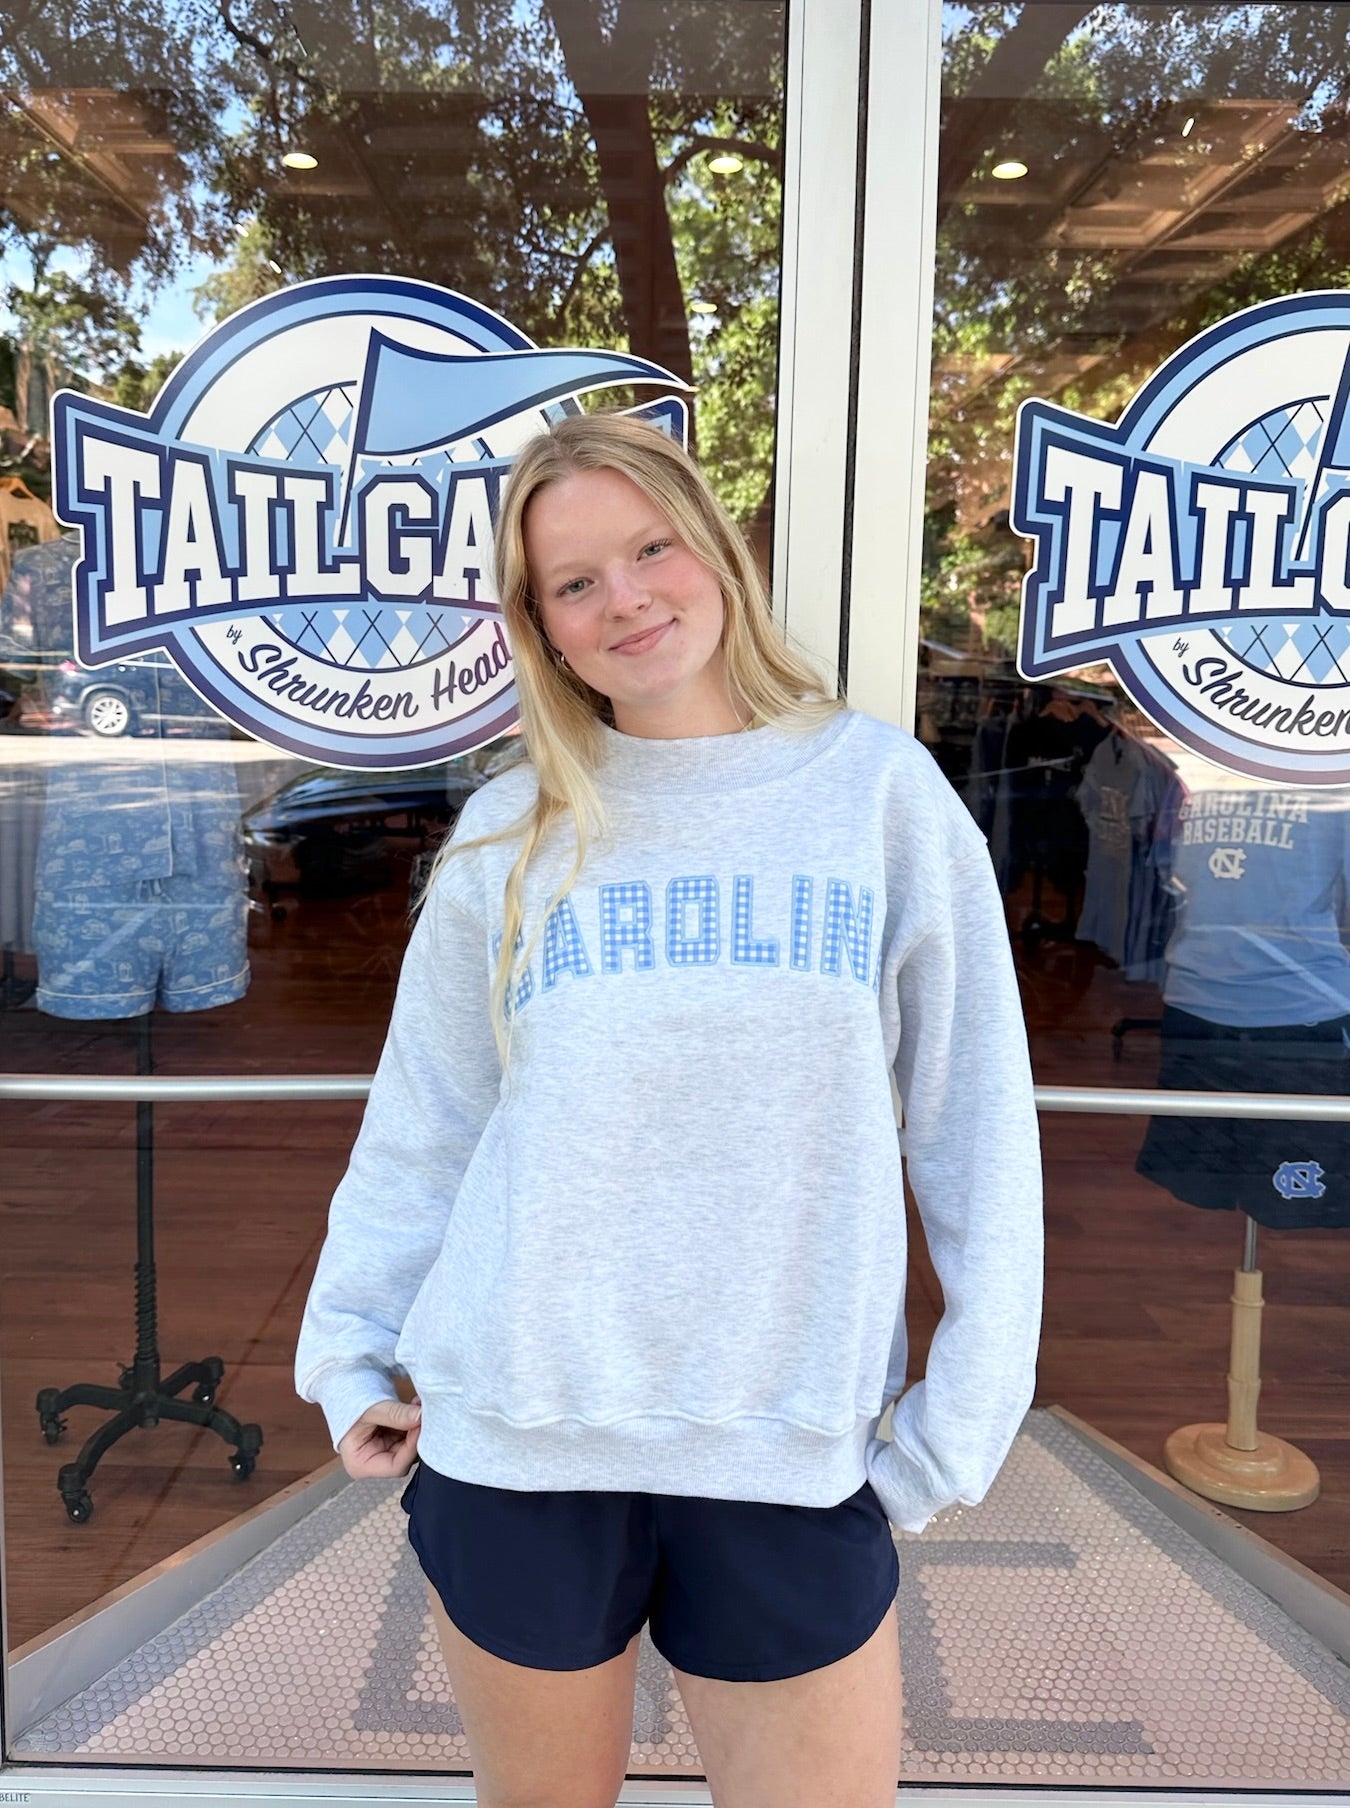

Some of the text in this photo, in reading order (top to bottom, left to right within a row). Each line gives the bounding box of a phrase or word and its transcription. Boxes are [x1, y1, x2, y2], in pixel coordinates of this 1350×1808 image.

[82, 435, 512, 626] TAILGA
[226, 620, 513, 721] by Shrunken Head
[1172, 636, 1191, 659] by
[1178, 791, 1309, 824] CAROLINA
[1182, 817, 1294, 850] BASEBALL
[491, 873, 881, 1022] AROLIN
